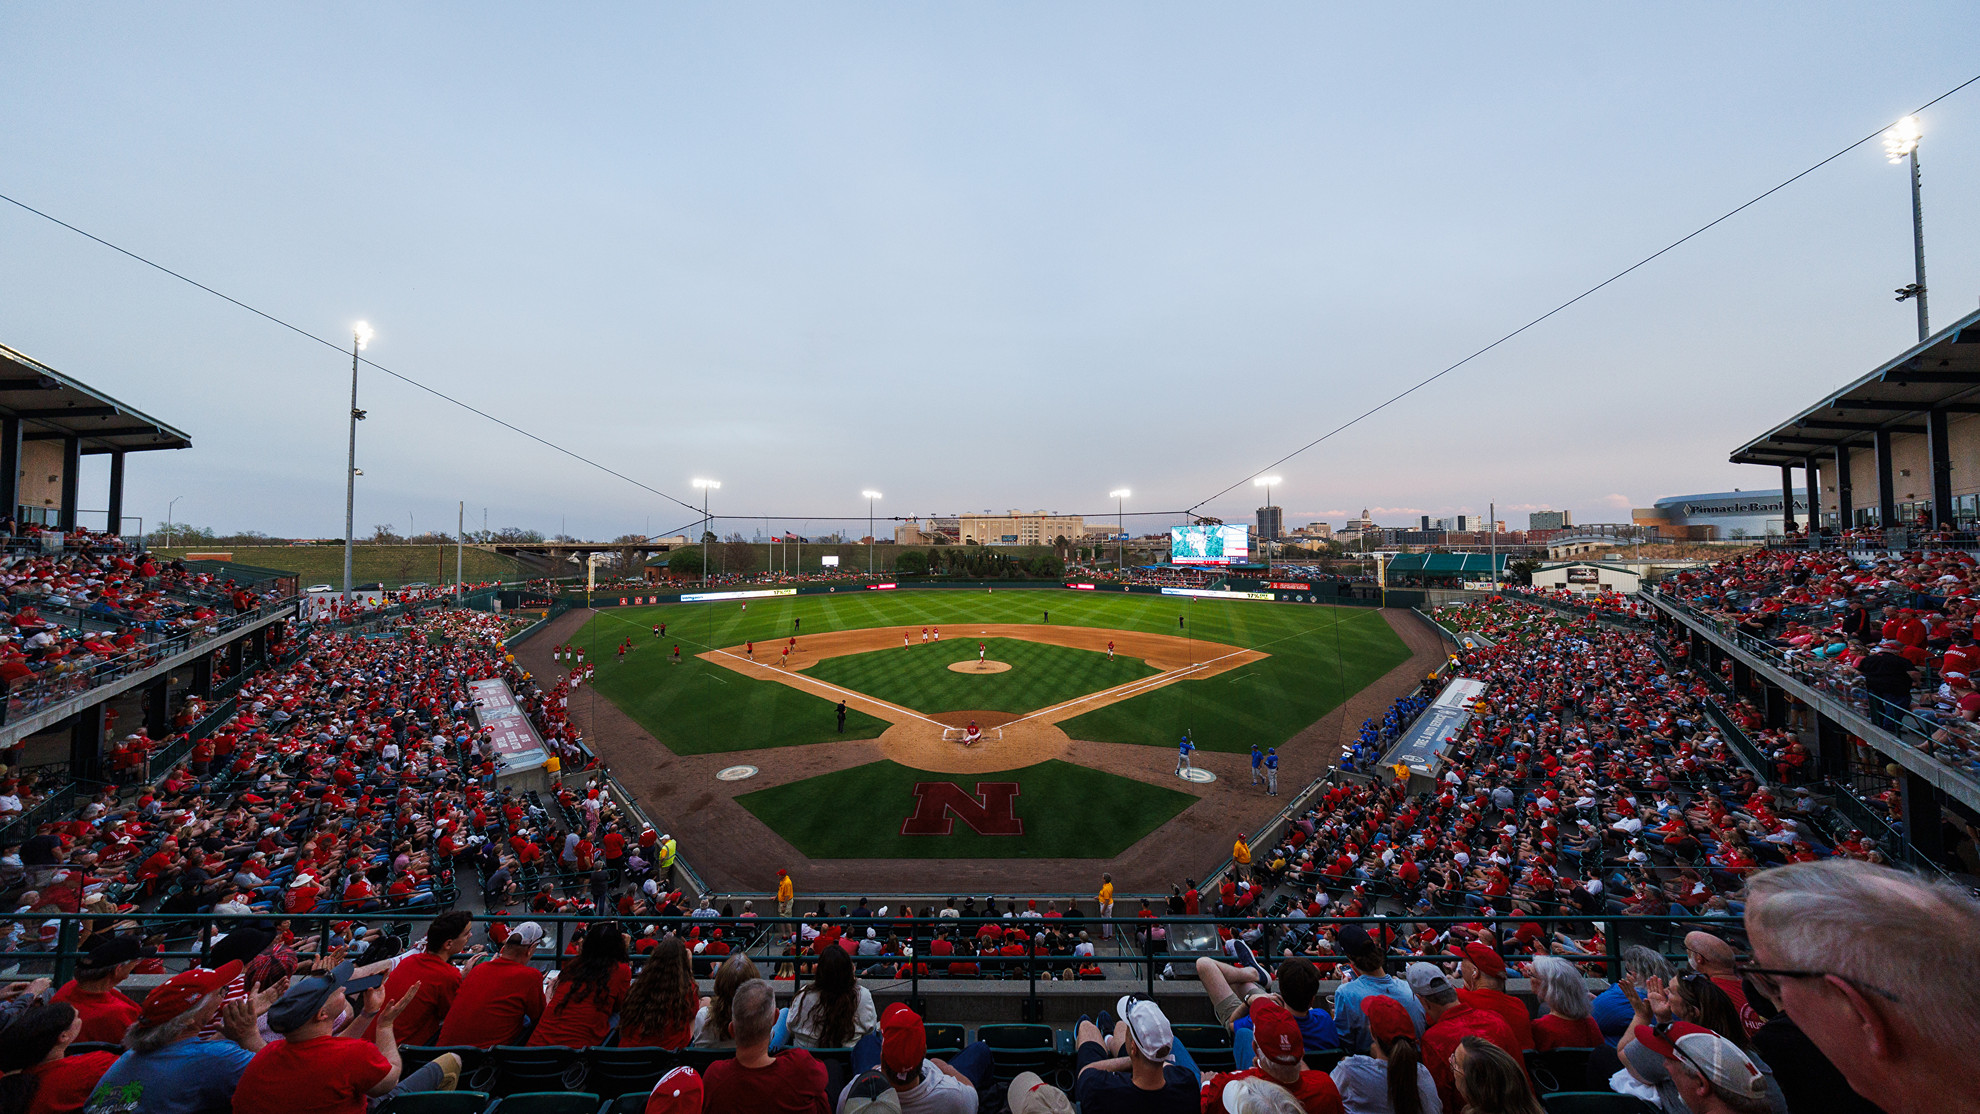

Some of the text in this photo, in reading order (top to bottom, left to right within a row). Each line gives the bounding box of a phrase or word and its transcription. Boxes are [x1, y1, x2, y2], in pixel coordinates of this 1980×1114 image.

[1692, 502, 1748, 514] Pinnacle
[900, 782, 1024, 836] N
[1279, 1034, 1290, 1044] N
